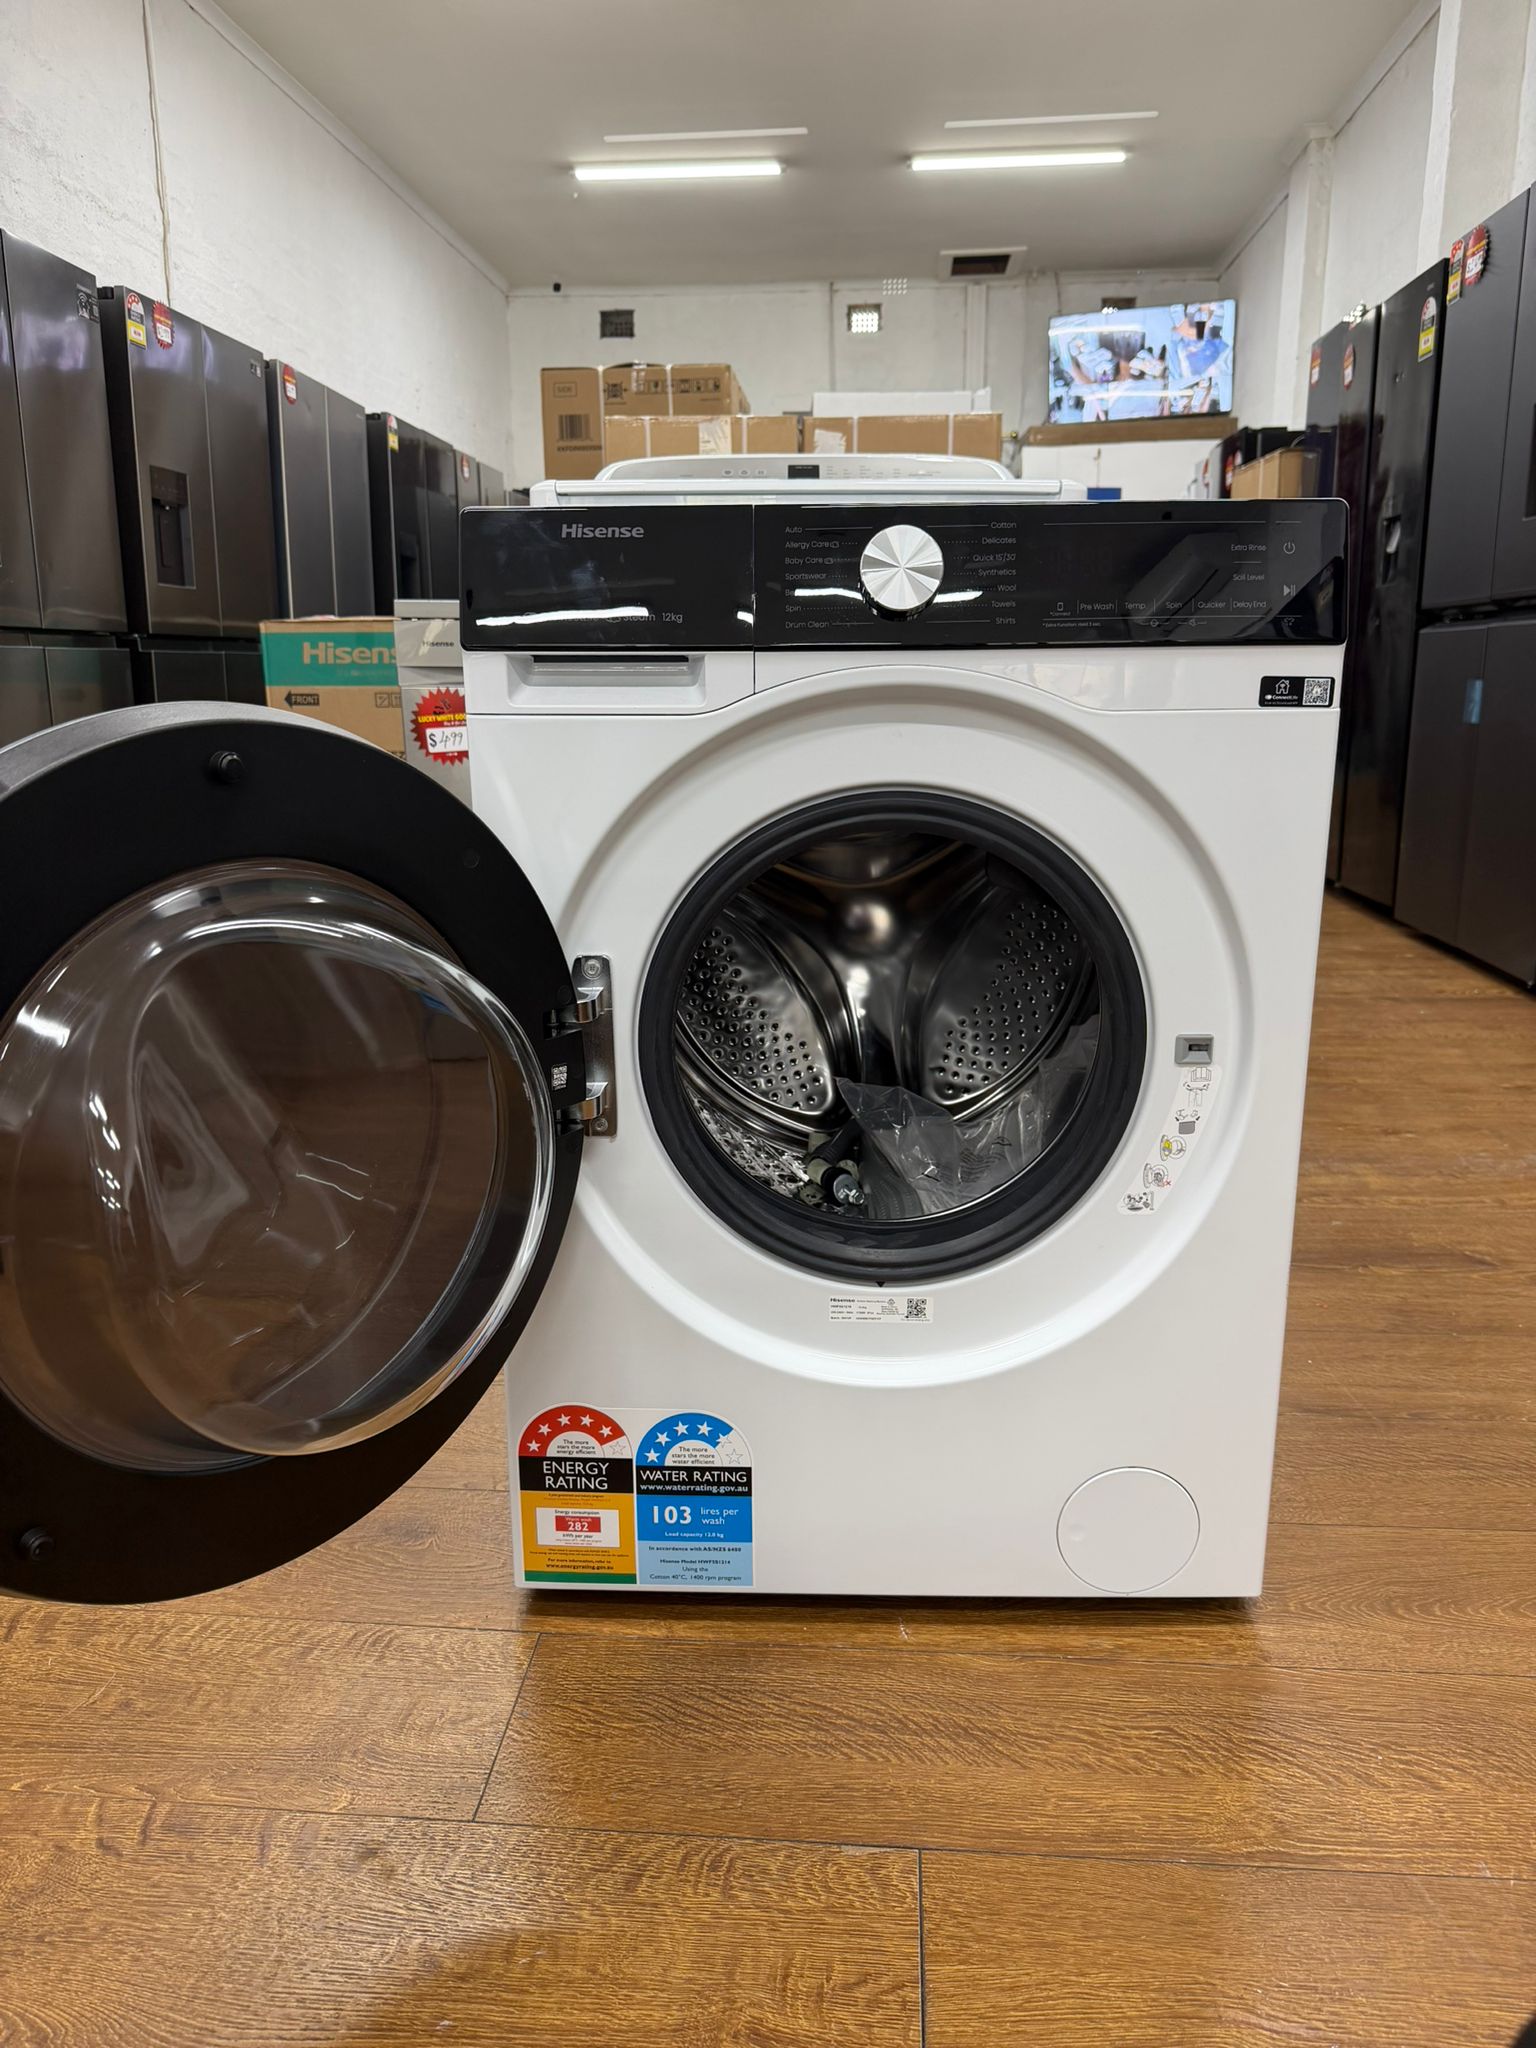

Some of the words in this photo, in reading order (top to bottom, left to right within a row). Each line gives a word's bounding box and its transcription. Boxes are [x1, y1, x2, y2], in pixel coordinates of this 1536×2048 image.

[561, 523, 644, 538] Hisense
[785, 541, 810, 550] Allergy
[978, 569, 1016, 577] Synthetics
[1166, 601, 1183, 610] Spin
[1233, 601, 1252, 609] Delay
[662, 613, 683, 623] 12kg
[292, 695, 318, 705] FRONT
[543, 1461, 609, 1475] ENERGY
[640, 1470, 688, 1482] WATER
[694, 1471, 747, 1483] RATING
[545, 1475, 608, 1490] RATING
[640, 1484, 748, 1493] www.waterrating.gov.au
[653, 1506, 692, 1524] 103
[723, 1508, 739, 1517] per
[702, 1517, 725, 1525] wash
[568, 1522, 589, 1532] 282
